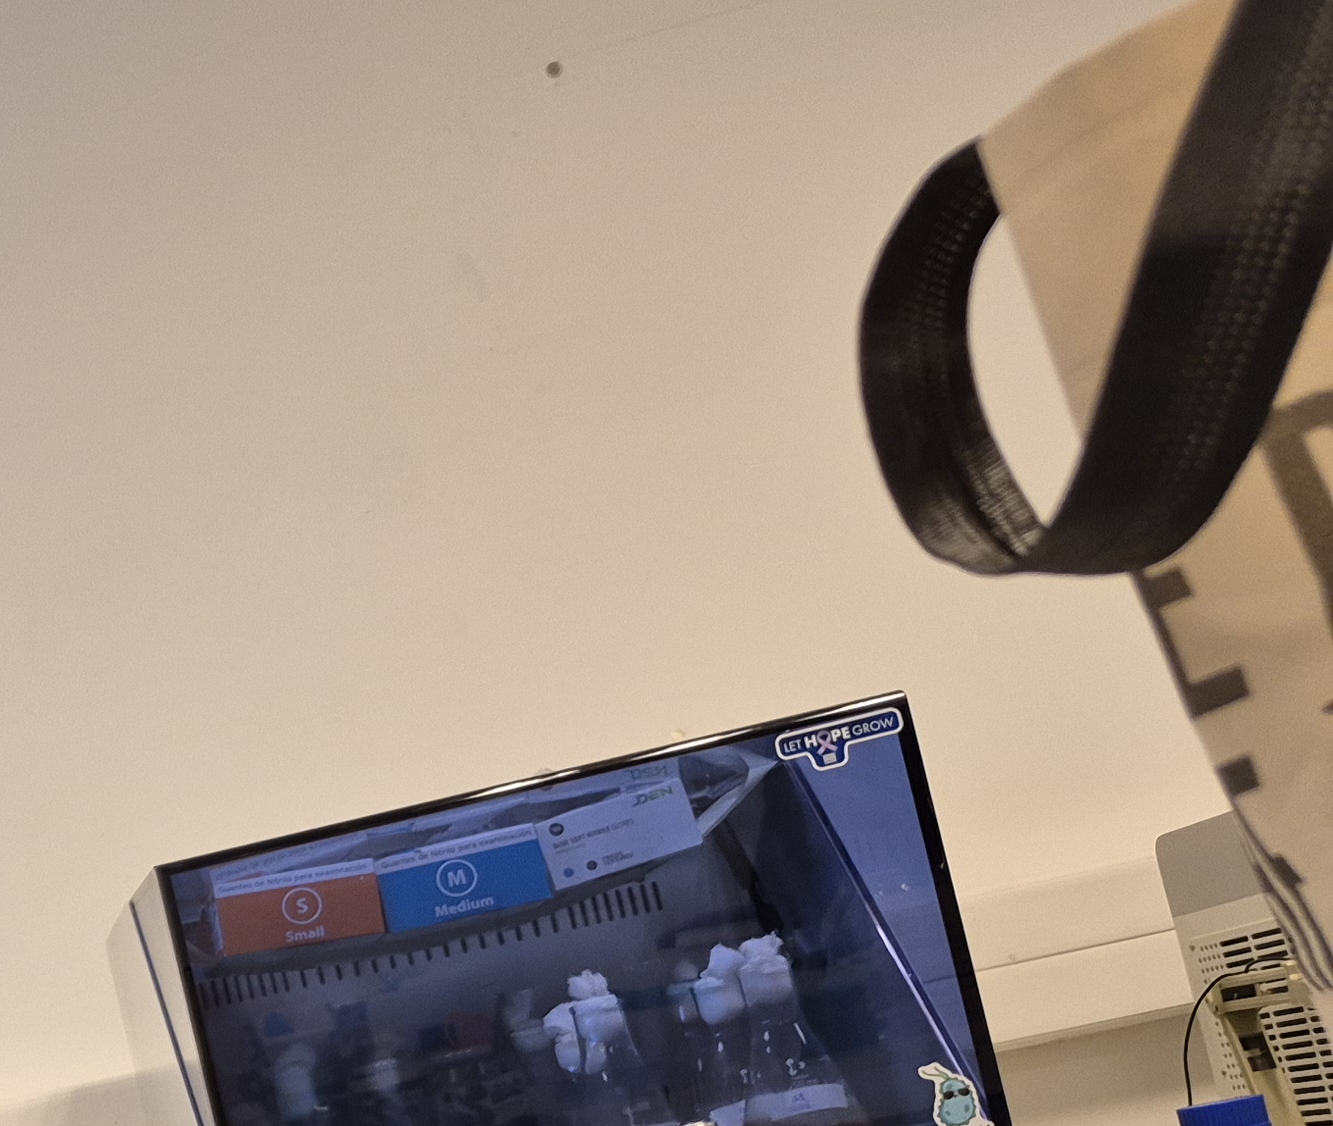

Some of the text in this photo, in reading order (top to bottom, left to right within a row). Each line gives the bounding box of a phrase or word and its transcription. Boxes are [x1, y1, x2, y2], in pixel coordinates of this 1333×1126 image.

[784, 716, 894, 753] LET HOPE GROW
[418, 851, 428, 861] de
[458, 842, 477, 854] para
[218, 882, 252, 894] Guantes
[254, 879, 264, 888] de
[294, 872, 312, 883] para
[447, 869, 467, 888] M
[296, 897, 309, 914] S
[435, 896, 494, 918] Medium
[286, 926, 325, 943] Small
